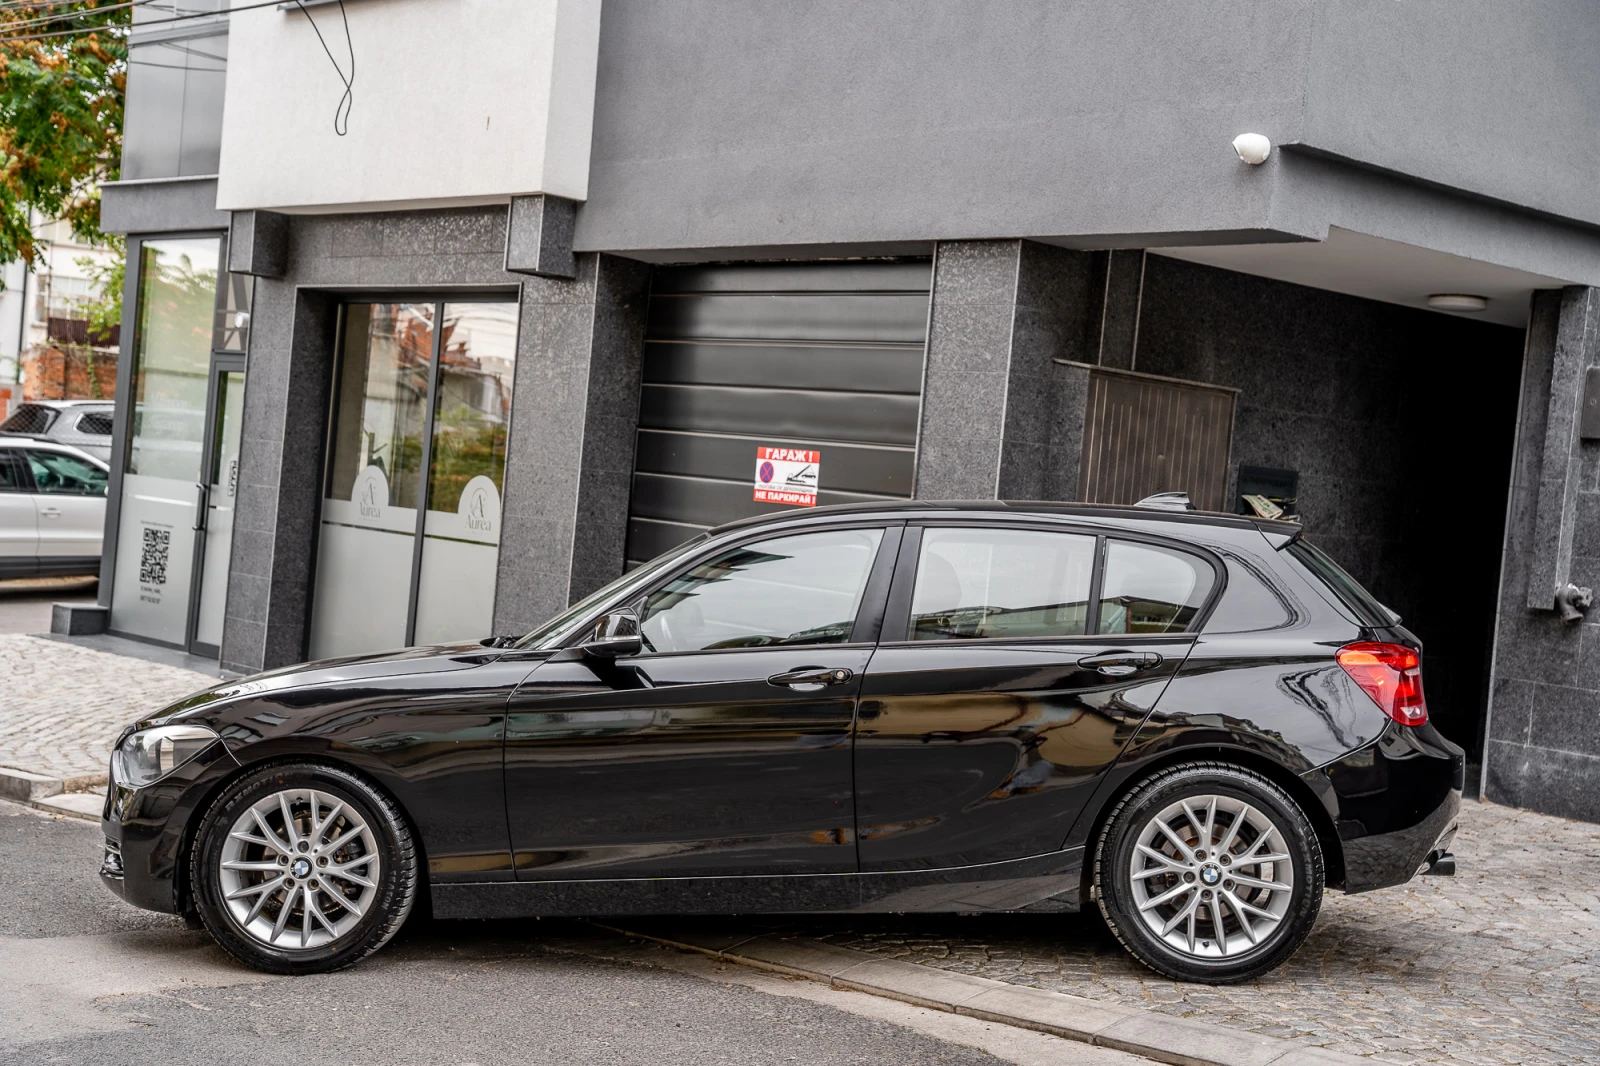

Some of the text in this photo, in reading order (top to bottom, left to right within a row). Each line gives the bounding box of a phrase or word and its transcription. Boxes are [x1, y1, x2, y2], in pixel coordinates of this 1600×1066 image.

[765, 447, 806, 462] ГАРАЖ
[755, 490, 767, 499] НЕ
[768, 492, 811, 504] ПАРКИРАЙ
[464, 514, 492, 531] Aurea
